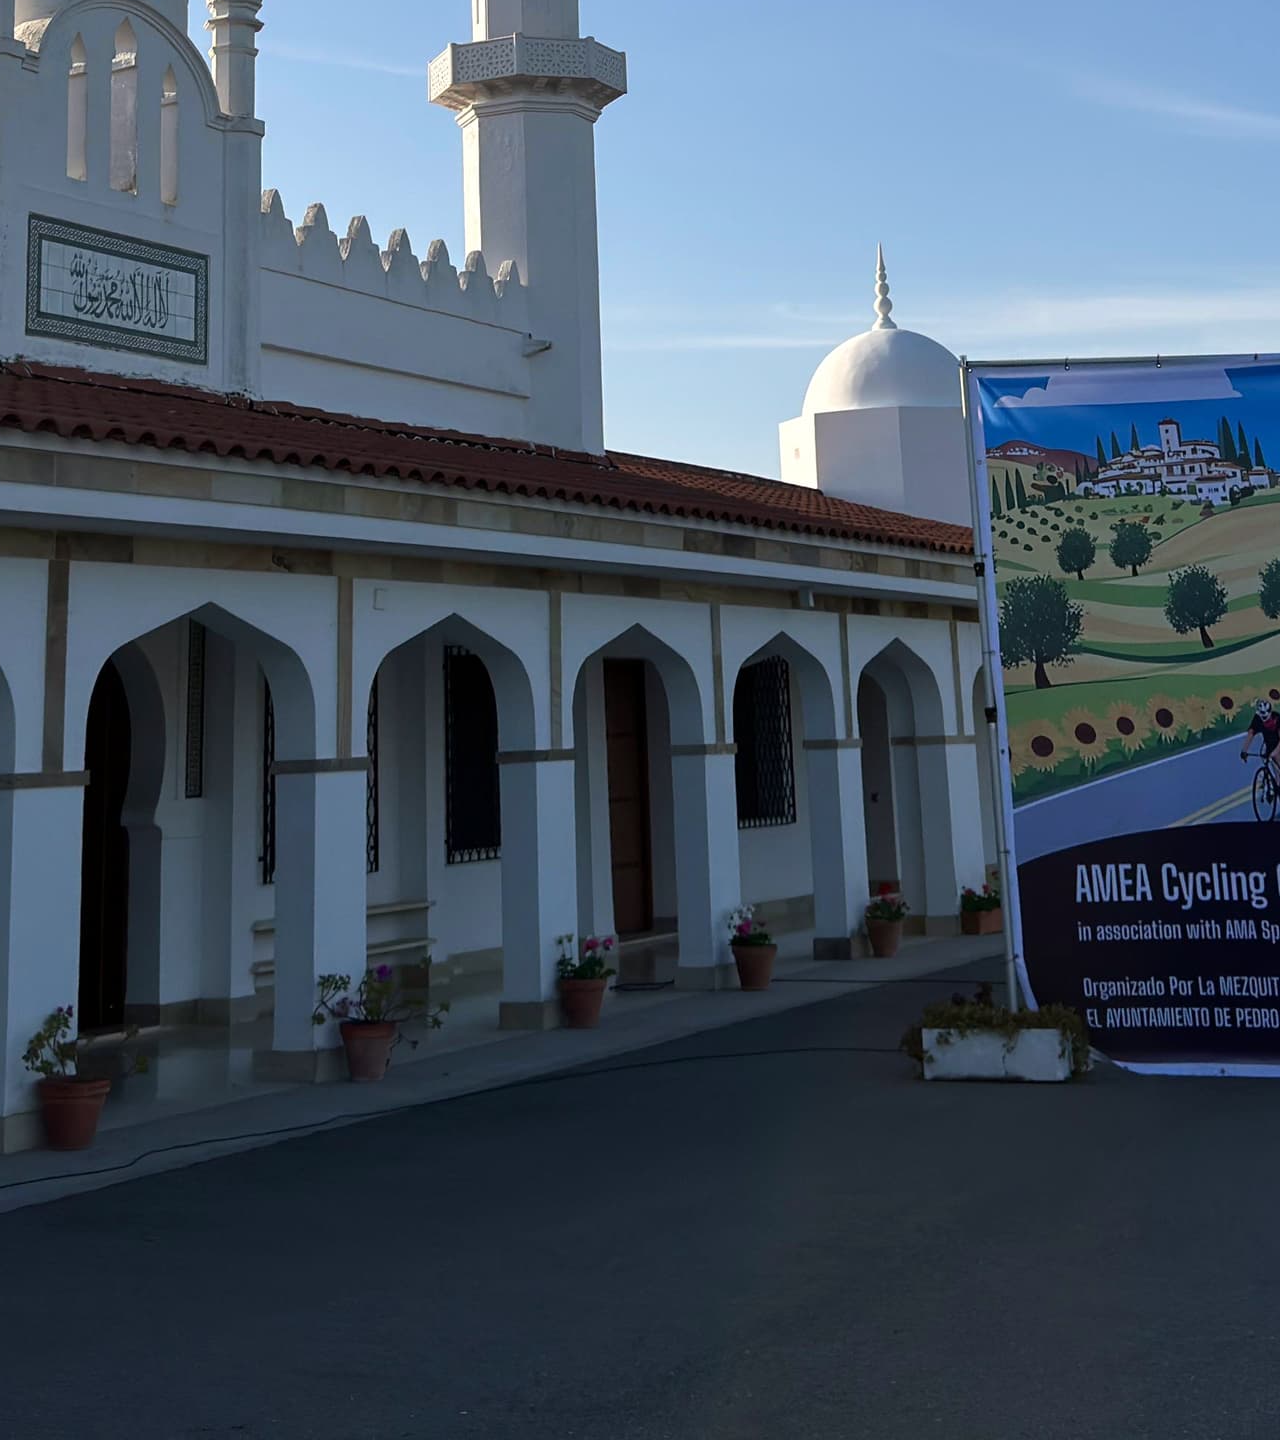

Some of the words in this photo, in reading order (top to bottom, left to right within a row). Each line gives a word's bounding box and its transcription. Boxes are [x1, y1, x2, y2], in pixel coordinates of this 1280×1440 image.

[1075, 863, 1153, 903] AMEA
[1161, 862, 1269, 910] Cycling
[1077, 921, 1092, 942] in
[1096, 920, 1182, 941] association
[1186, 919, 1221, 940] with
[1225, 919, 1257, 940] AMA
[1083, 976, 1165, 1000] Organizado
[1169, 976, 1193, 997] Por
[1198, 976, 1215, 997] La
[1087, 1008, 1103, 1028] EL
[1106, 1007, 1210, 1028] AYUNTAMIENTO
[1215, 1008, 1231, 1027] DE
[1236, 1008, 1279, 1029] PEDRO
